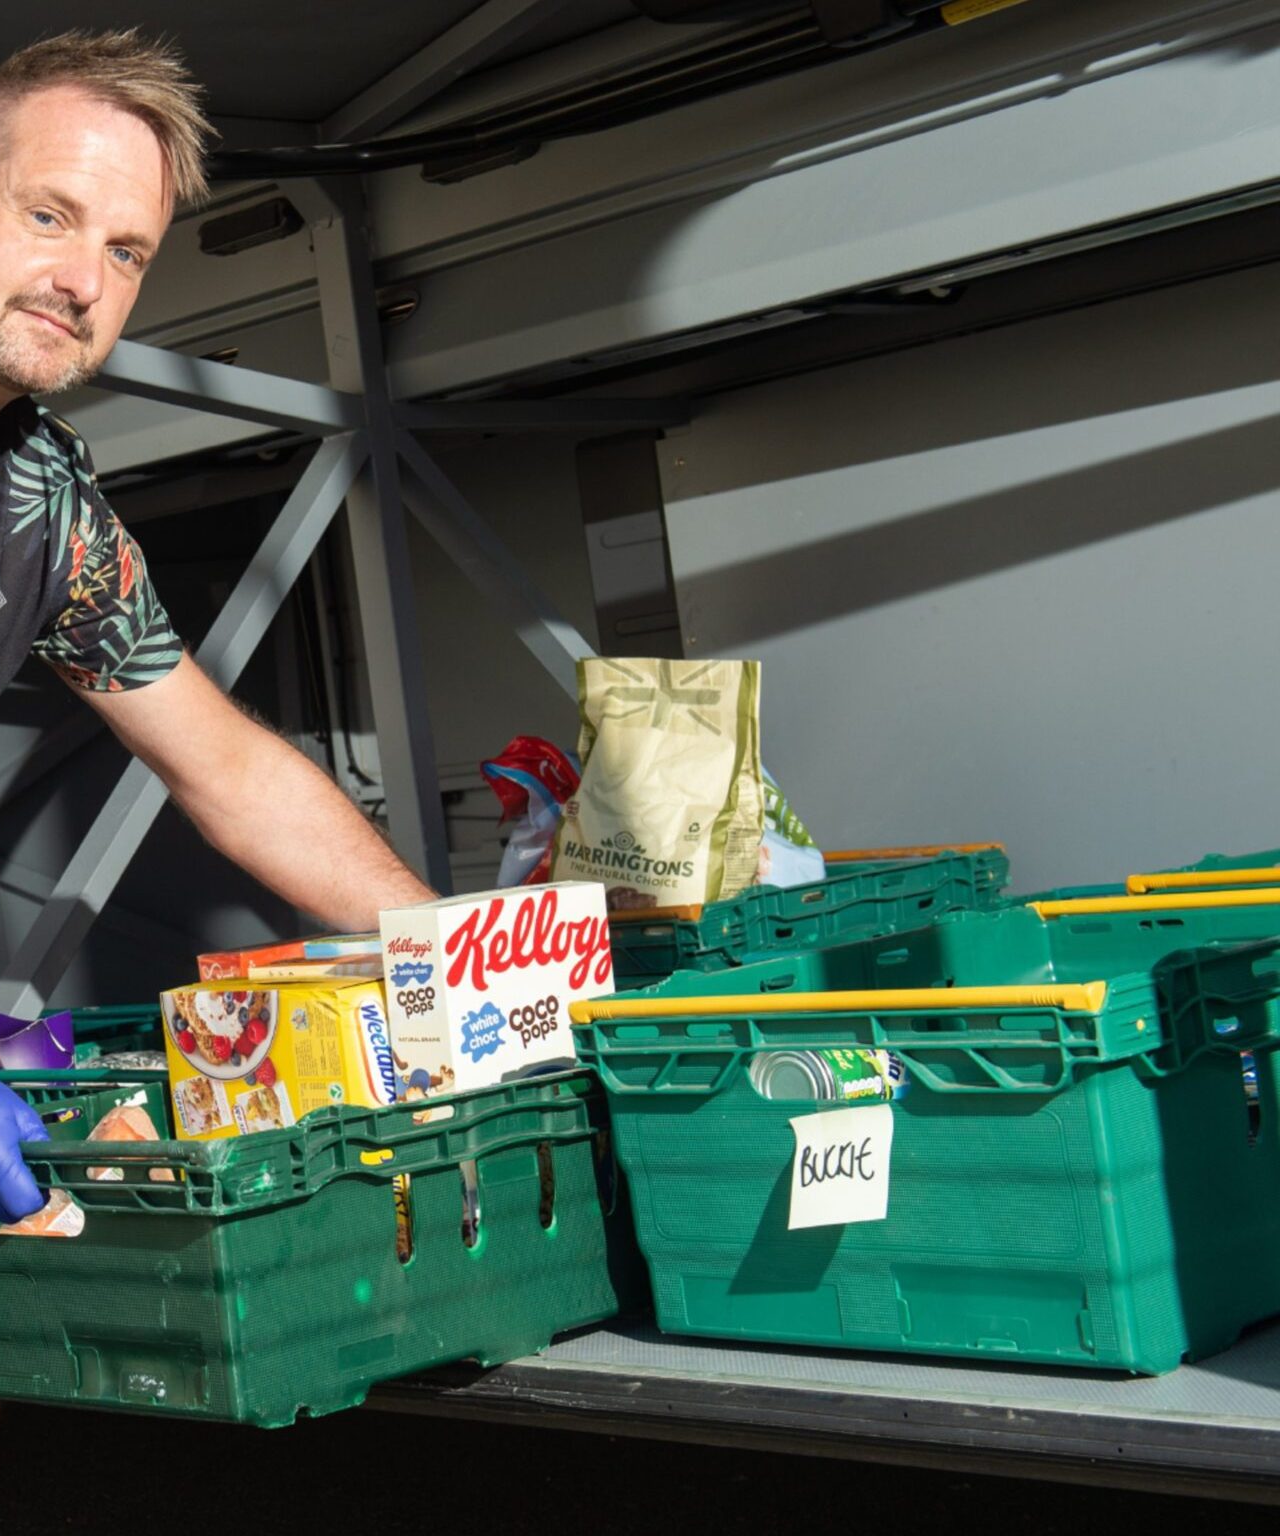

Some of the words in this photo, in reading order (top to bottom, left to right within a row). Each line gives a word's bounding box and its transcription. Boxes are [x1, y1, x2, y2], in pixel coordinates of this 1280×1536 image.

[564, 841, 694, 878] HARRINGTONS
[570, 861, 585, 873] THE
[635, 874, 679, 888] CHOICE
[388, 937, 432, 958] Kellogg's
[405, 1001, 434, 1019] pops
[469, 1013, 500, 1034] white
[521, 1016, 558, 1049] pops
[469, 1030, 497, 1049] choc
